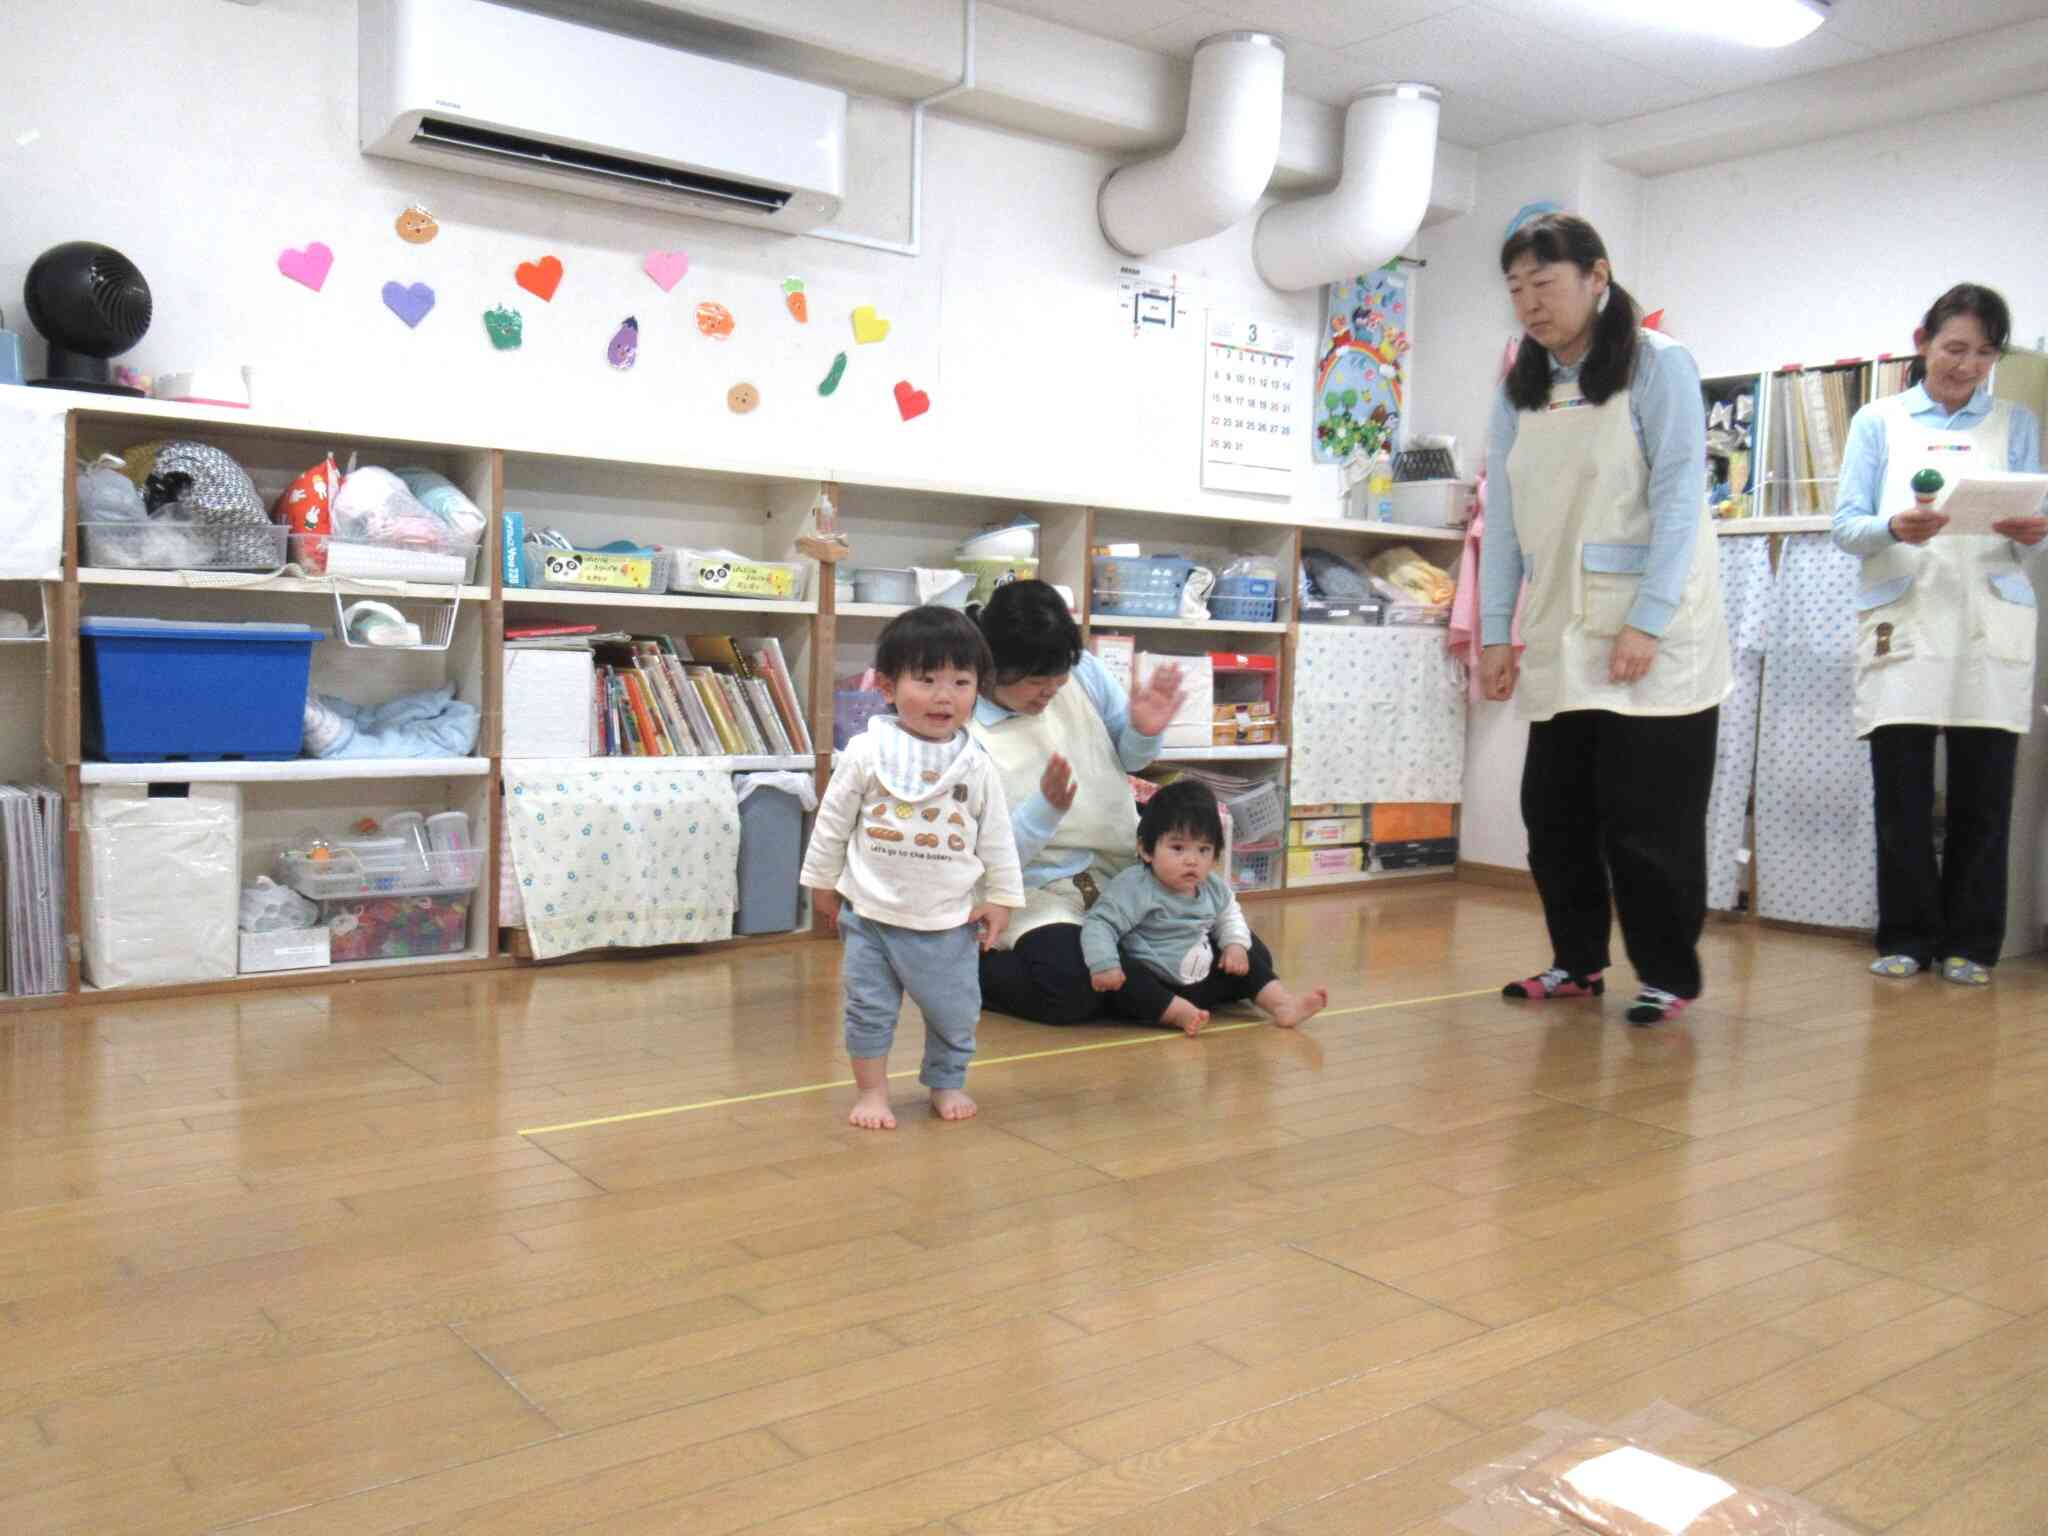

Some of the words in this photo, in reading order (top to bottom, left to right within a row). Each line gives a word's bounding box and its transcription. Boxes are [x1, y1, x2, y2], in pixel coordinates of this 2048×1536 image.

[1249, 324, 1258, 342] 3
[1270, 425, 1278, 433] 27
[899, 849, 908, 857] to
[910, 851, 925, 859] the
